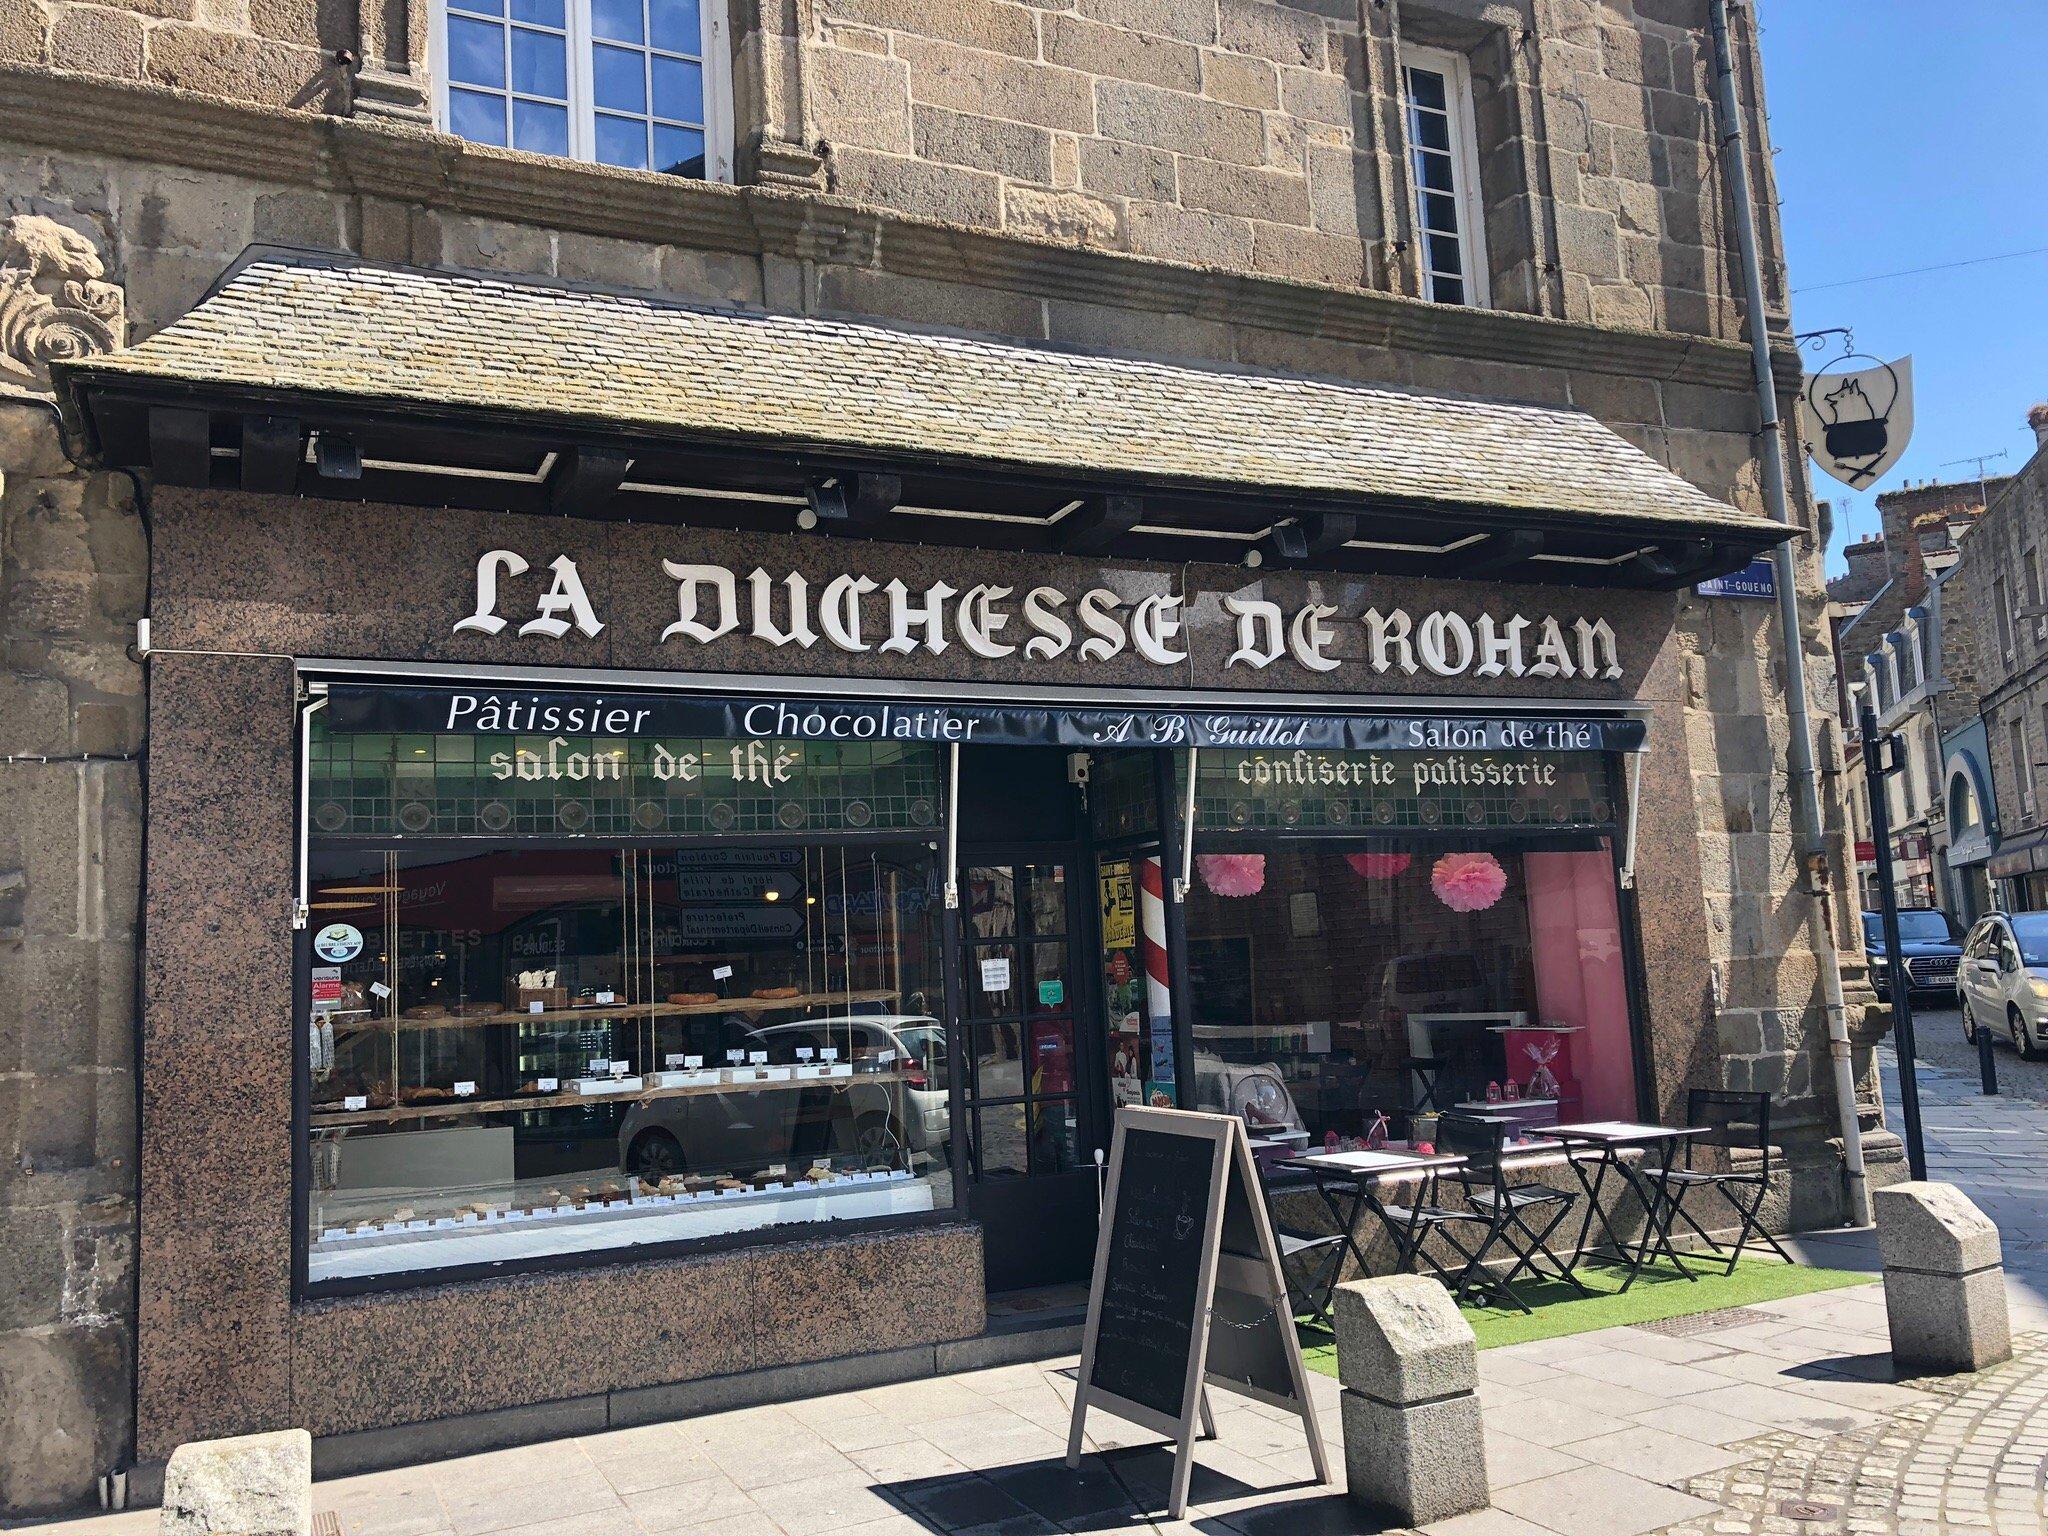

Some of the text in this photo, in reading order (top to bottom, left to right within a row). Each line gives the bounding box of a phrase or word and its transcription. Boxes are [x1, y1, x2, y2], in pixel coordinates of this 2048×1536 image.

[453, 550, 1625, 681] LA DUCHESSE DE ROHAN
[447, 695, 651, 734] Pâtissier
[744, 703, 980, 741] Chocolatier
[1093, 714, 1310, 746] A B Guillot
[1408, 719, 1592, 749] Salon de thé
[489, 736, 793, 788] salon de thé
[1238, 749, 1396, 786] confiserie
[313, 981, 340, 989] Alarme
